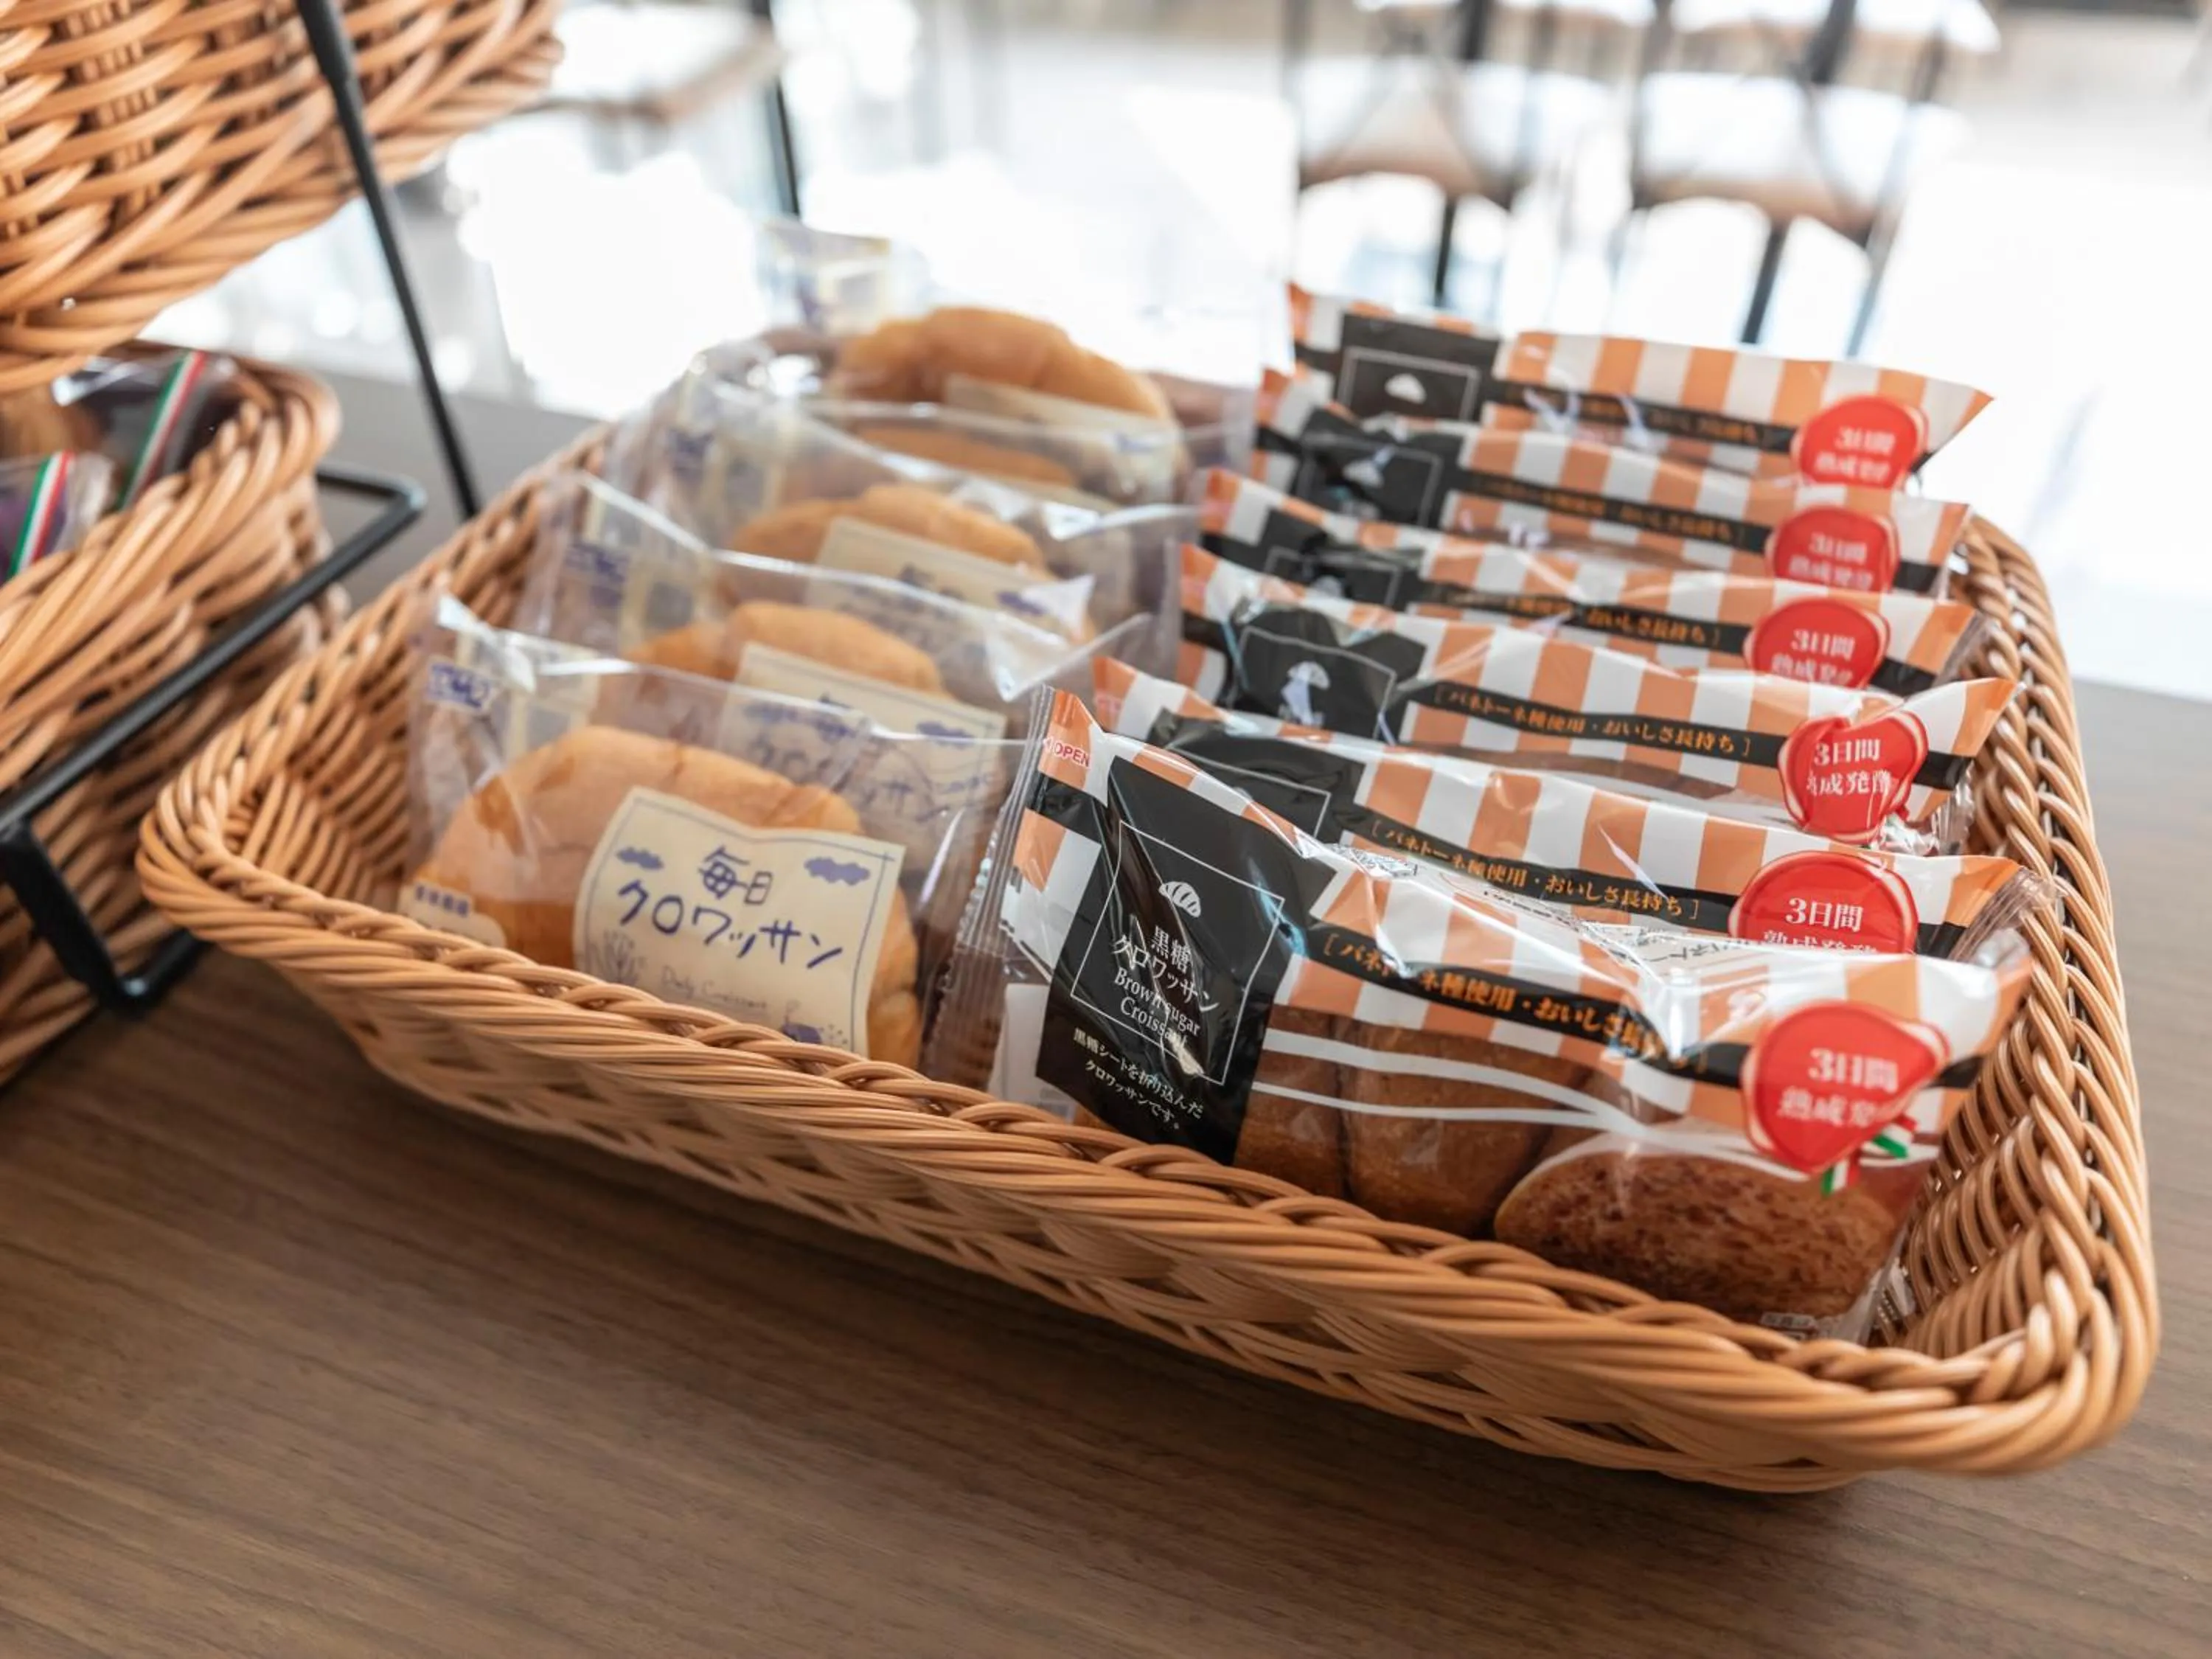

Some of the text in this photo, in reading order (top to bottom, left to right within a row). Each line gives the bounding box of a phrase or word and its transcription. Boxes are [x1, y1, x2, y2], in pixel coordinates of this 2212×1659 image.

[1055, 741, 1089, 768] OPEN
[1813, 738, 1881, 766] 3日間
[698, 844, 773, 905] 毎日
[618, 879, 844, 969] クロワッサン
[1784, 896, 1864, 933] 3日間
[1111, 933, 1220, 1013] クロワッサン
[1151, 924, 1192, 975] 黒糖
[1113, 966, 1164, 1009] Brown
[1120, 995, 1188, 1049] Croissa
[1808, 1047, 1898, 1093] 3日間
